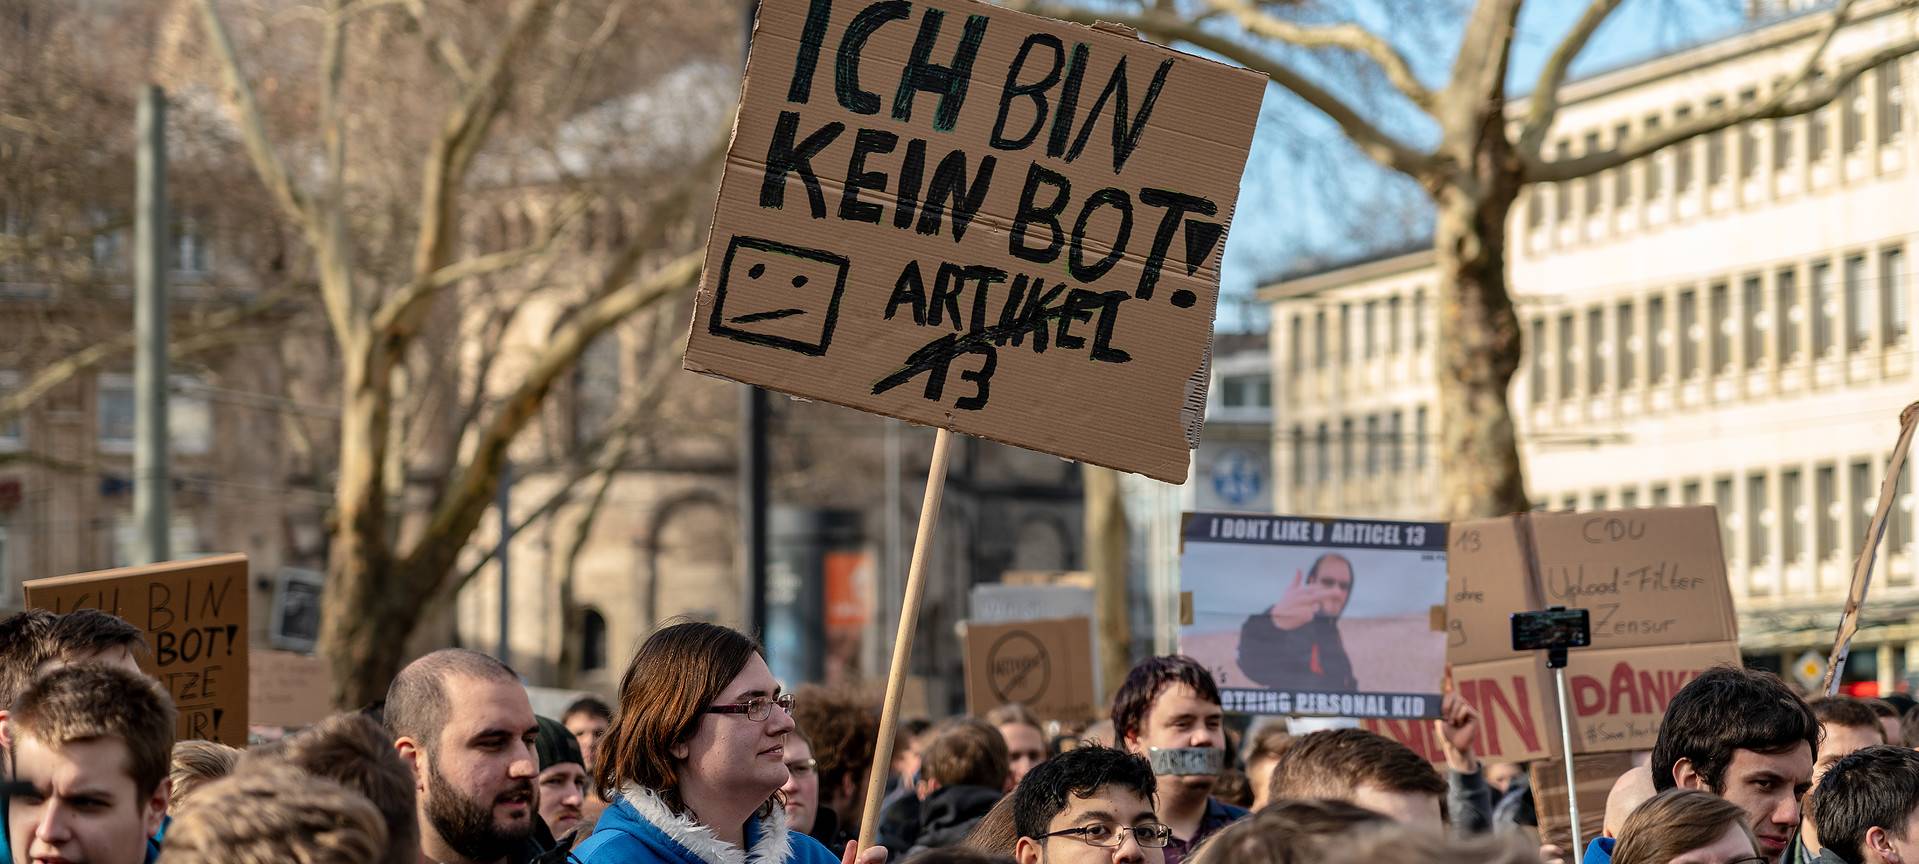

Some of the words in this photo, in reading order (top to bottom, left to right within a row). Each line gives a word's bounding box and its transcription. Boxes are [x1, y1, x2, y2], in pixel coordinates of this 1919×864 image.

[787, 0, 990, 133] ICH
[989, 33, 1175, 175] BIN
[760, 110, 997, 243] KEIN
[1009, 160, 1225, 308] BOT!
[884, 260, 1133, 364] ARTIKEL
[893, 333, 999, 410] 13
[1210, 518, 1218, 538] I
[1221, 518, 1268, 540] DONT
[1272, 520, 1310, 542] LIKE
[1331, 523, 1401, 545] ARTICEL
[1405, 526, 1426, 546] 13
[1455, 529, 1482, 553] 13
[1583, 517, 1646, 544] CDU
[1549, 561, 1705, 607] Upload-Filter
[148, 576, 233, 632] BIN
[1592, 602, 1677, 638] Zensur
[157, 624, 239, 667] BOT!
[158, 665, 223, 701] TZE
[1219, 690, 1292, 712] OTHING
[1294, 692, 1388, 716] PERSONAL
[1391, 696, 1425, 717] KID
[186, 708, 224, 742] IR!
